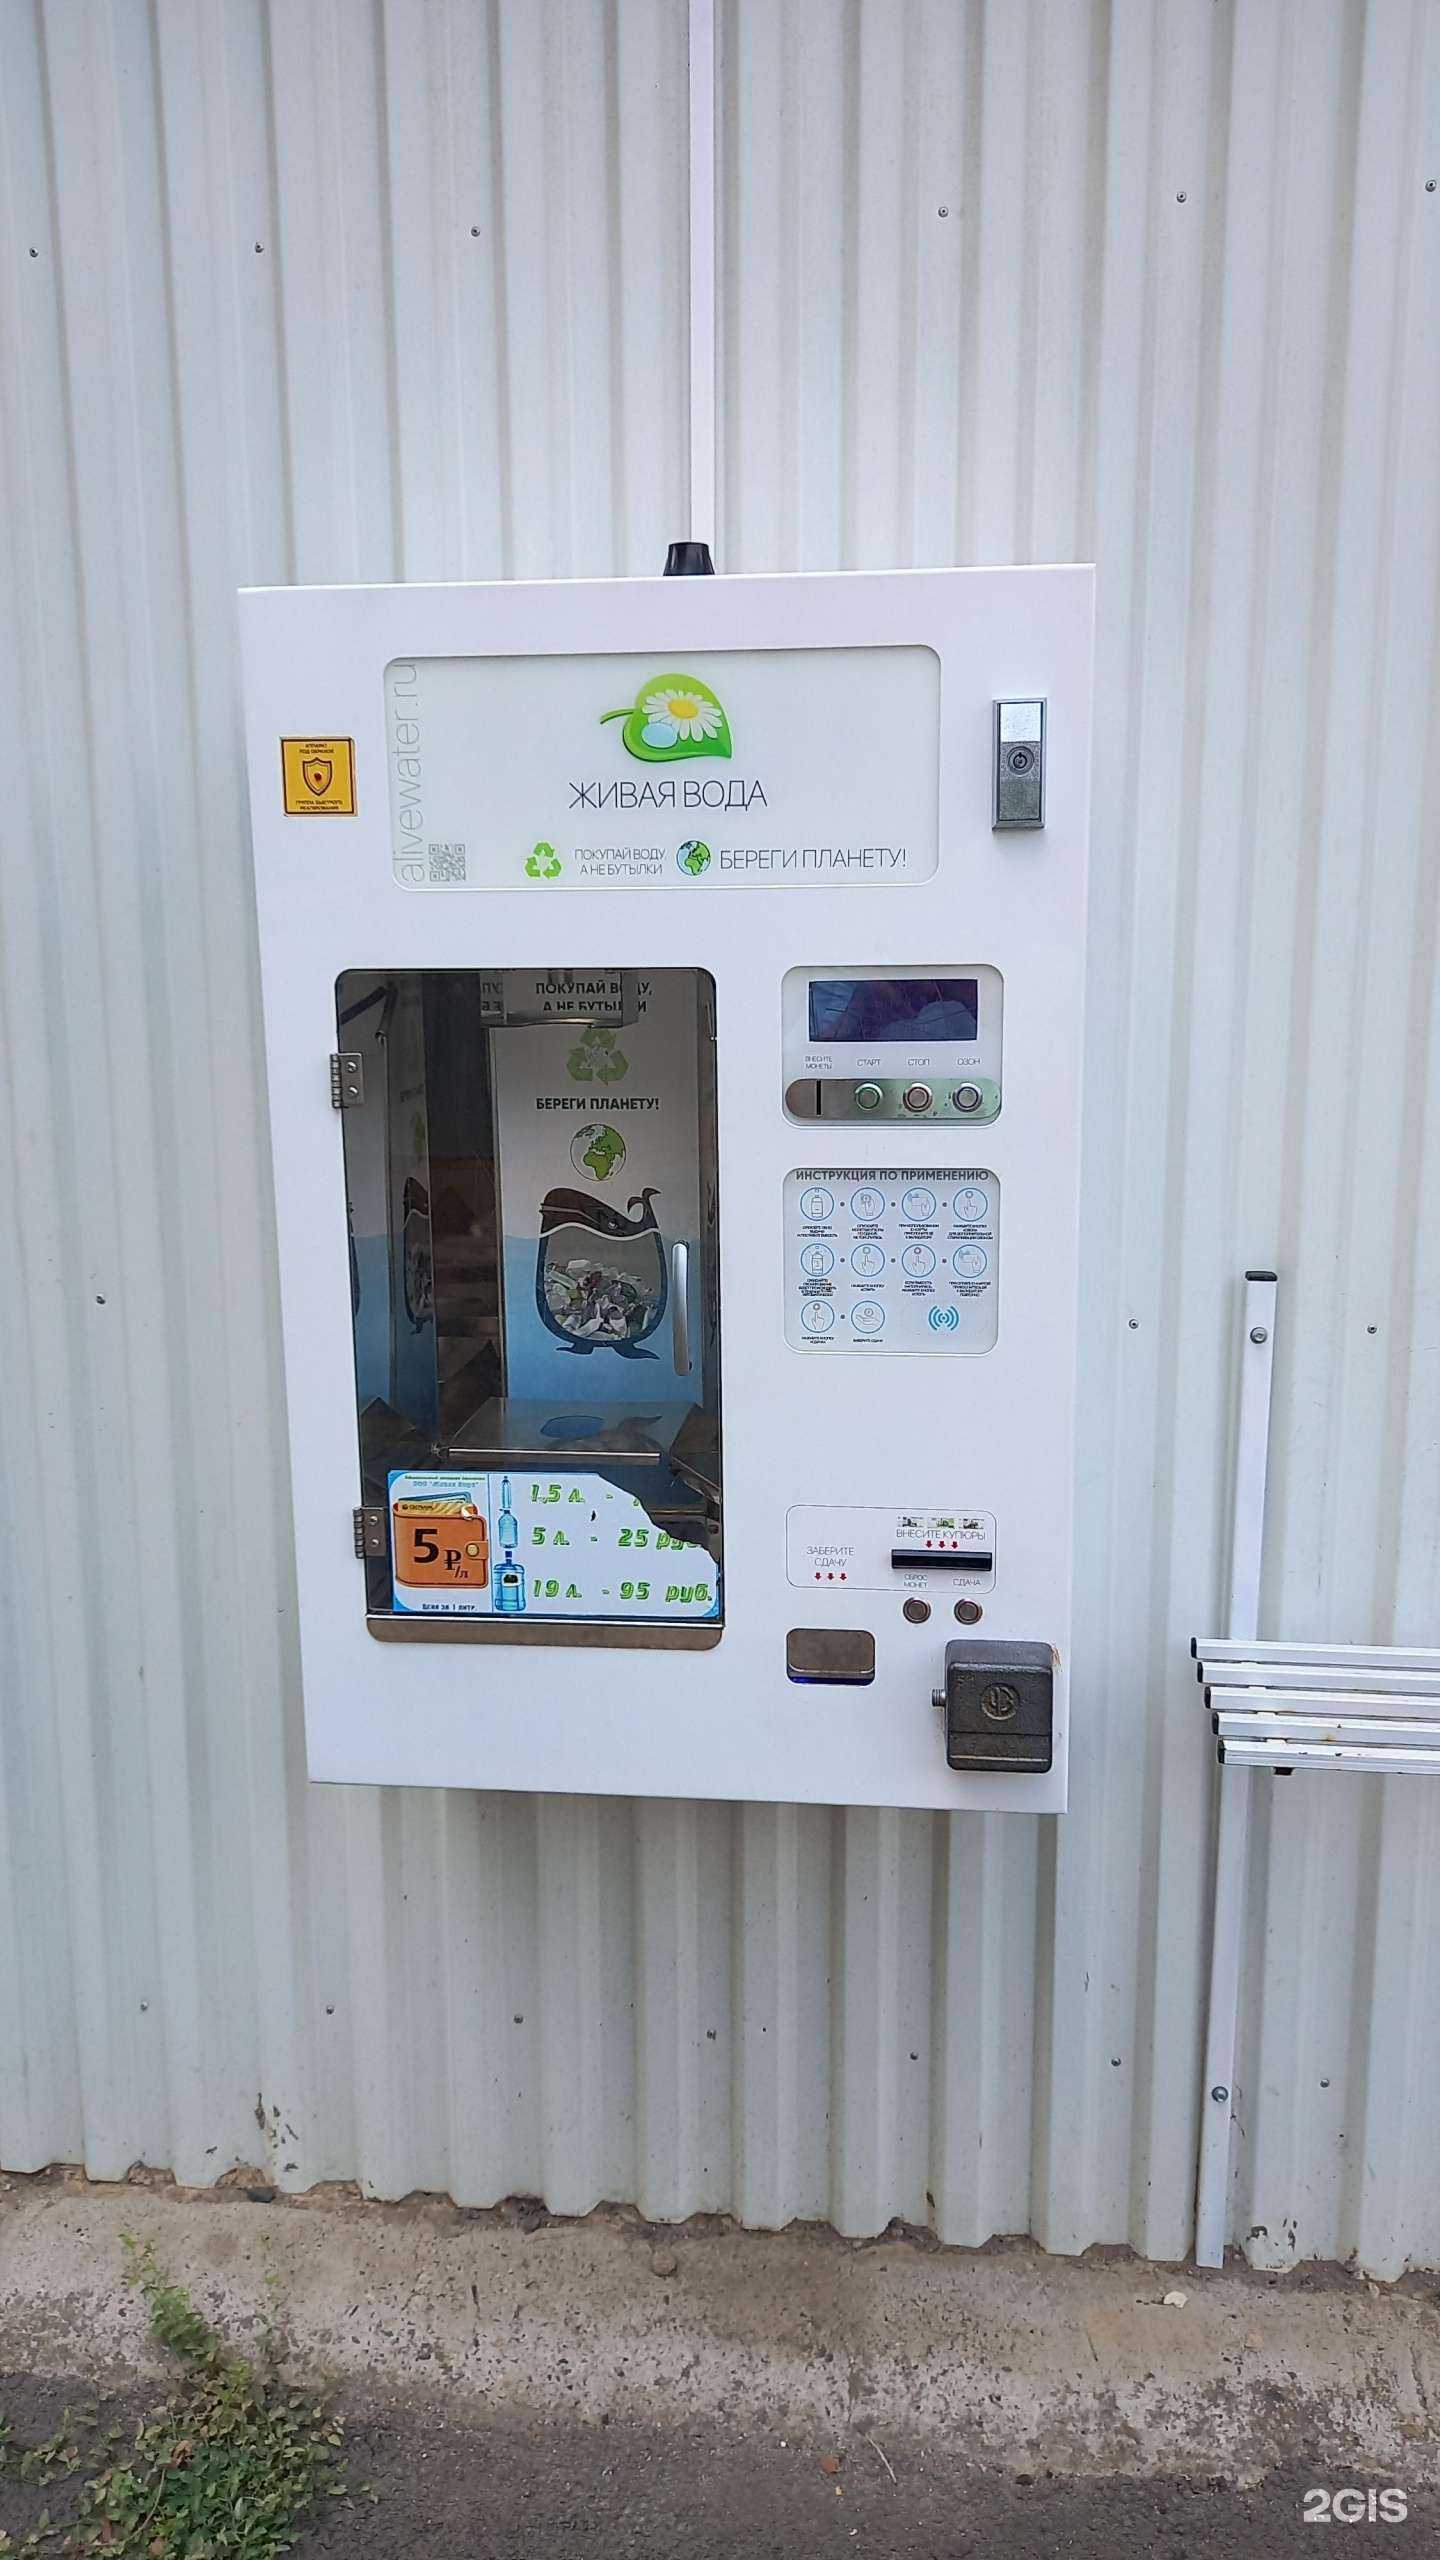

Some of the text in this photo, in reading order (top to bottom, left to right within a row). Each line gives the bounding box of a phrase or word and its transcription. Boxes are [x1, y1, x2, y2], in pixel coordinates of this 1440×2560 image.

[392, 663, 425, 883] alivewater.ru
[569, 780, 768, 812] ЖИВАЯ ВОДА
[575, 847, 632, 860] ПОКУПАЙ
[720, 848, 907, 870] БЕРЕГИ ПЛАНЕТУ!
[580, 864, 663, 876] А НЕ БУТЫЛКИ
[536, 979, 606, 995] ПОКУПАЙ
[857, 1058, 881, 1067] СТАРТ
[908, 1058, 930, 1067] СТОП
[957, 1057, 981, 1066] ОЗОН
[536, 1097, 659, 1110] БЕРЕГИ ПЛАНЕТУ!
[796, 1170, 989, 1182] ИНСТРУКЦИЯ ПО ПРИМЕНЕНИЮ
[531, 1484, 562, 1504] 1,5
[532, 1526, 546, 1546] 5
[617, 1528, 649, 1548] 25
[896, 1528, 986, 1541] ВНЕСИТЕ КУПЮРЫ
[412, 1528, 440, 1564] 5
[806, 1545, 855, 1557] ЗАБЕРИТЕ
[814, 1557, 847, 1568] СДАЧУ
[953, 1578, 982, 1587] СДАЧА
[533, 1579, 560, 1599] 19
[619, 1581, 651, 1600] 95
[665, 1583, 713, 1603] руб.
